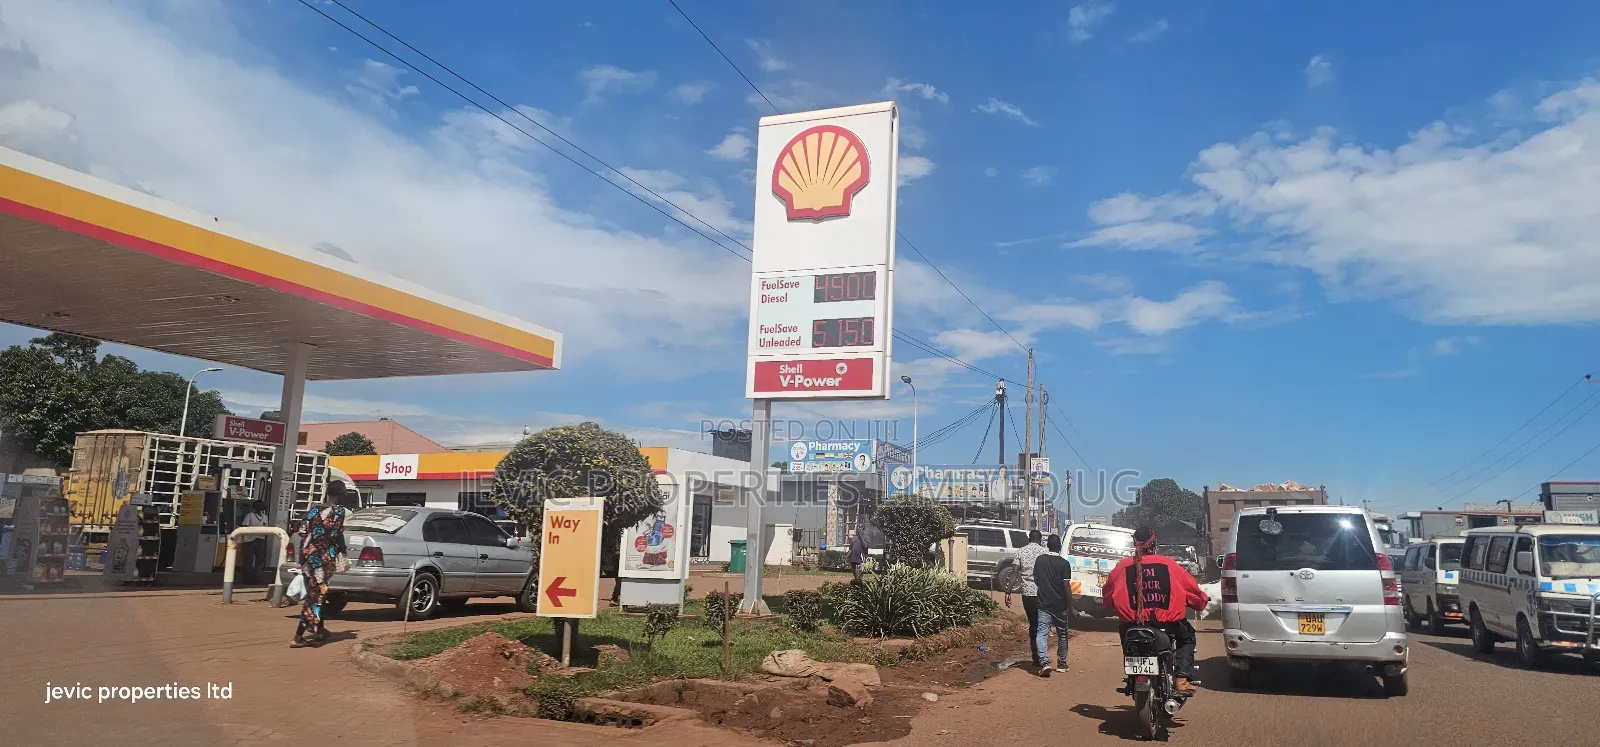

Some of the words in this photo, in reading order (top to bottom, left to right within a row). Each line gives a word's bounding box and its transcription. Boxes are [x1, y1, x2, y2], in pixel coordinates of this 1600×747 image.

[761, 279, 800, 290] FuelSave
[815, 272, 876, 302] 4900
[761, 293, 788, 303] Diesel
[759, 323, 798, 334] FuelSave
[813, 318, 875, 347] 5150
[759, 336, 802, 348] Unleaded
[779, 364, 803, 374] Shell
[779, 375, 842, 388] V-Power
[229, 420, 245, 428] Shell
[229, 427, 269, 440] V-Power
[808, 441, 861, 452] Pharmacy
[384, 462, 412, 476] Shop
[915, 466, 996, 482] Pharmacy
[550, 515, 581, 532] Way
[548, 531, 560, 545] In
[1083, 545, 1131, 557] TOYOTA
[1133, 580, 1161, 590] OUR
[1300, 623, 1323, 633] 729W
